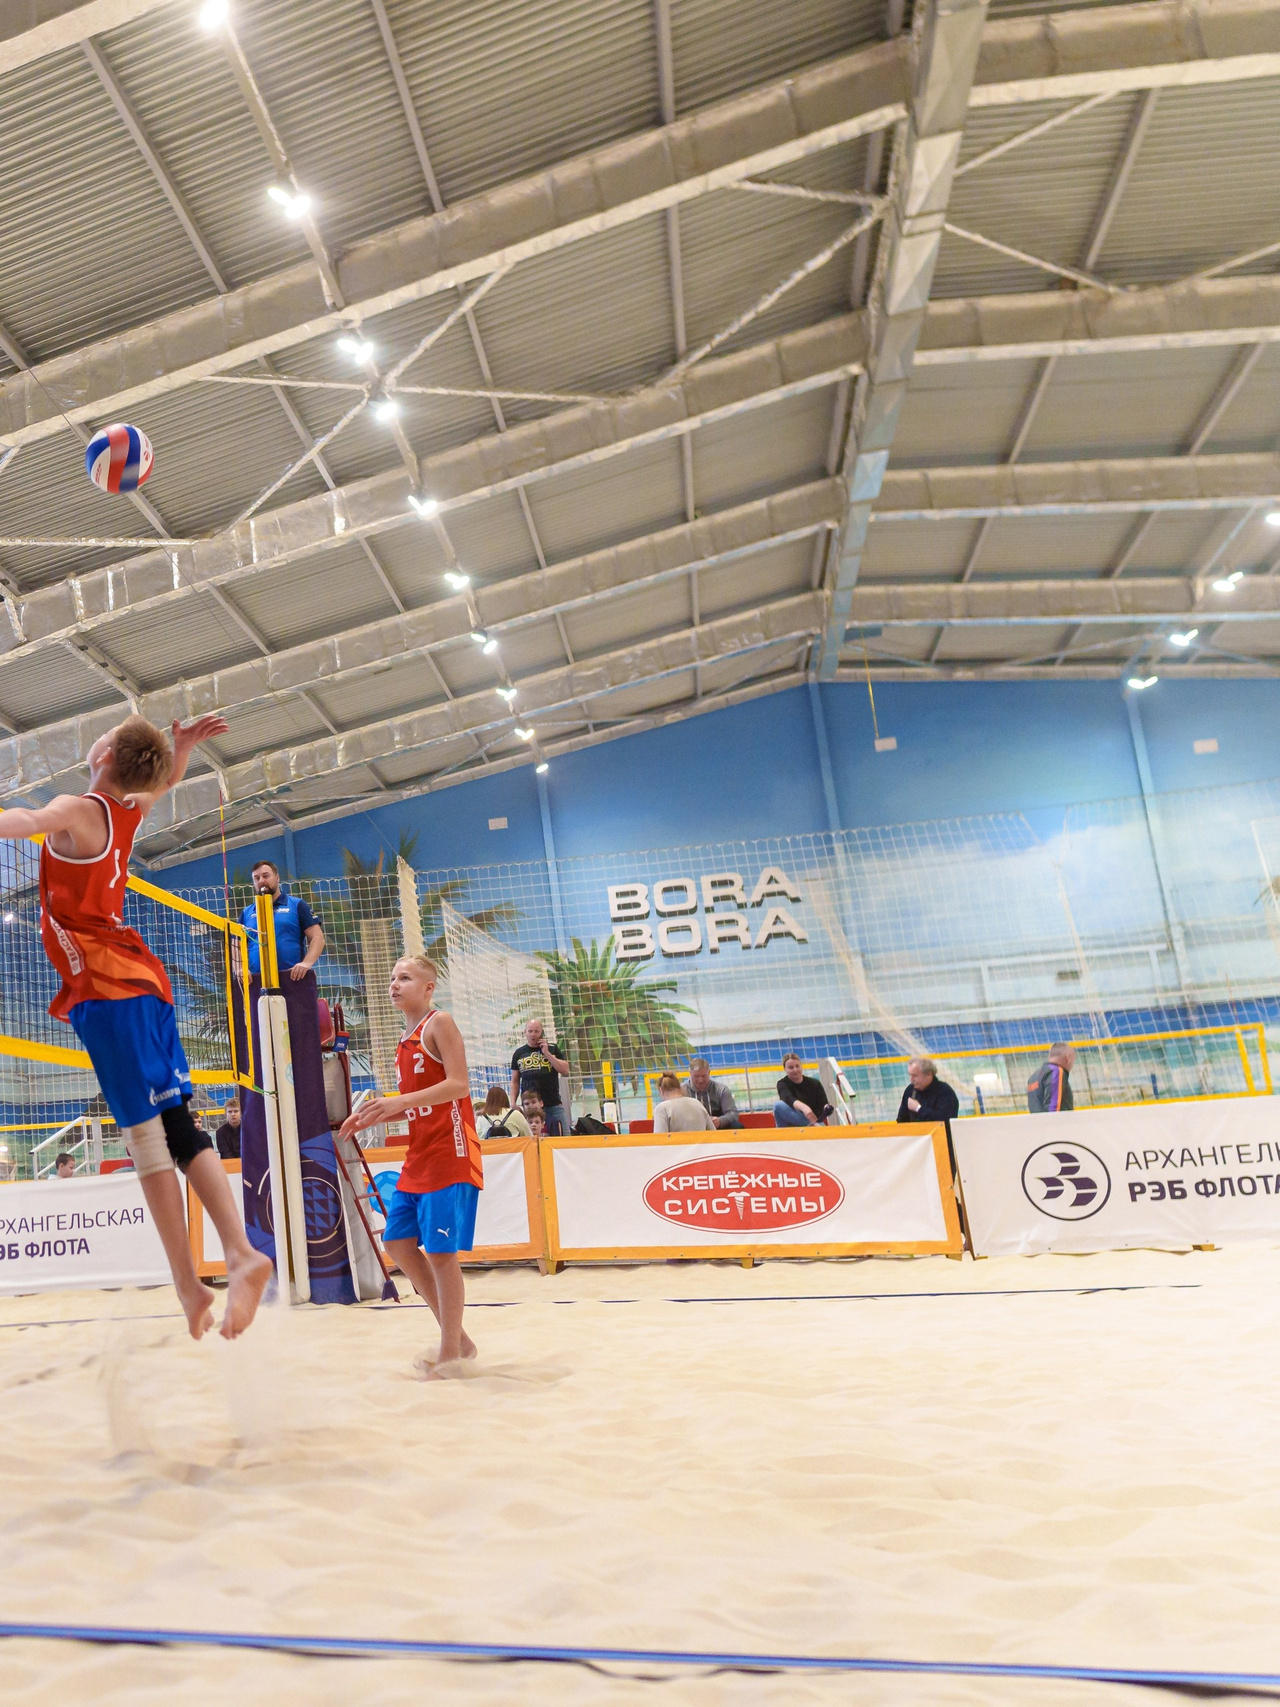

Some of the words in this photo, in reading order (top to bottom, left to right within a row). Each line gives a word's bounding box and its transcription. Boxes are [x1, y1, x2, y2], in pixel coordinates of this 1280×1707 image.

[607, 866, 802, 922] BORA
[612, 907, 809, 963] BORA
[412, 1052, 425, 1074] 2
[662, 1171, 822, 1192] КРЕПЁЖНЫЕ
[1128, 1179, 1188, 1202] РЭБ
[664, 1191, 826, 1221] СИСТЕМЫ
[24, 1238, 90, 1259] ФЛОТА
